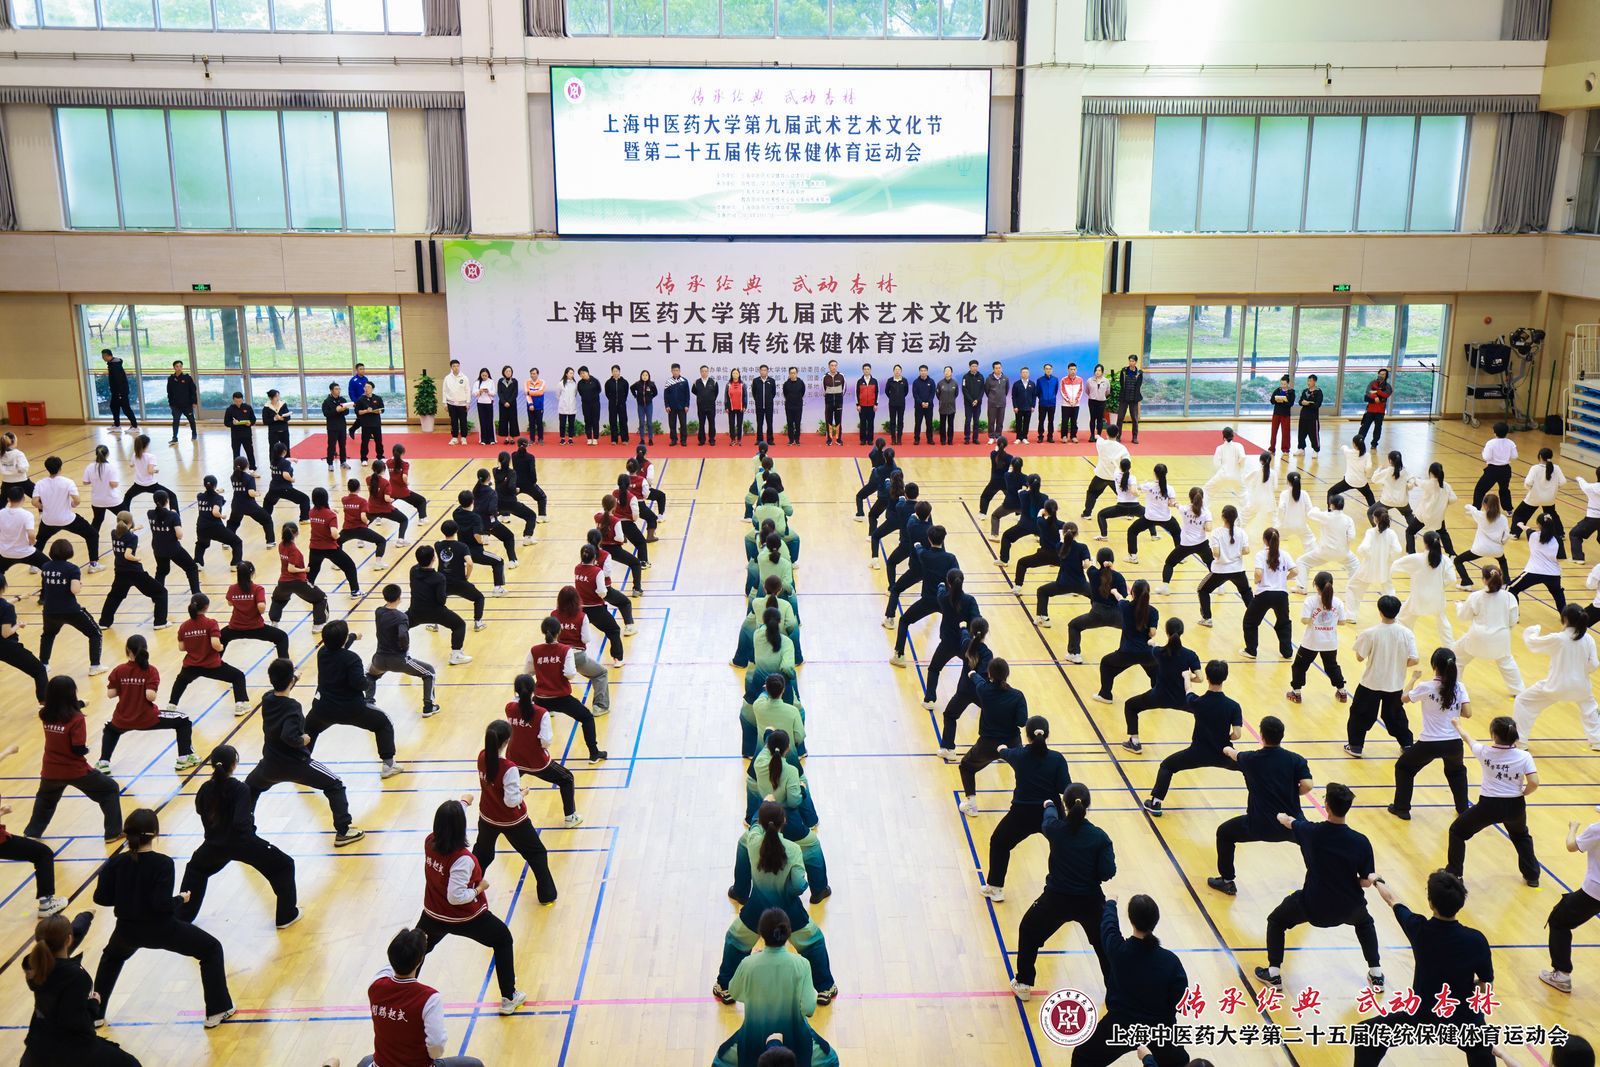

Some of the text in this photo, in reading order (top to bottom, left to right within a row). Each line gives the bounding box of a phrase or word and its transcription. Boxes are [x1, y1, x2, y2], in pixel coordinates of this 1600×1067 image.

[690, 88, 857, 106] 传承经典 武动杏林
[603, 114, 942, 135] 上海中医药大学第九届武术艺术文化节
[624, 142, 921, 162] 暨第二十五届传统保健体育运动会
[655, 272, 898, 295] 传承经典 武动杏林
[547, 301, 1006, 325] 上海中医药大学第九届武术艺术文化节
[575, 331, 978, 355] 暨第二十五届传统保健体育运动会
